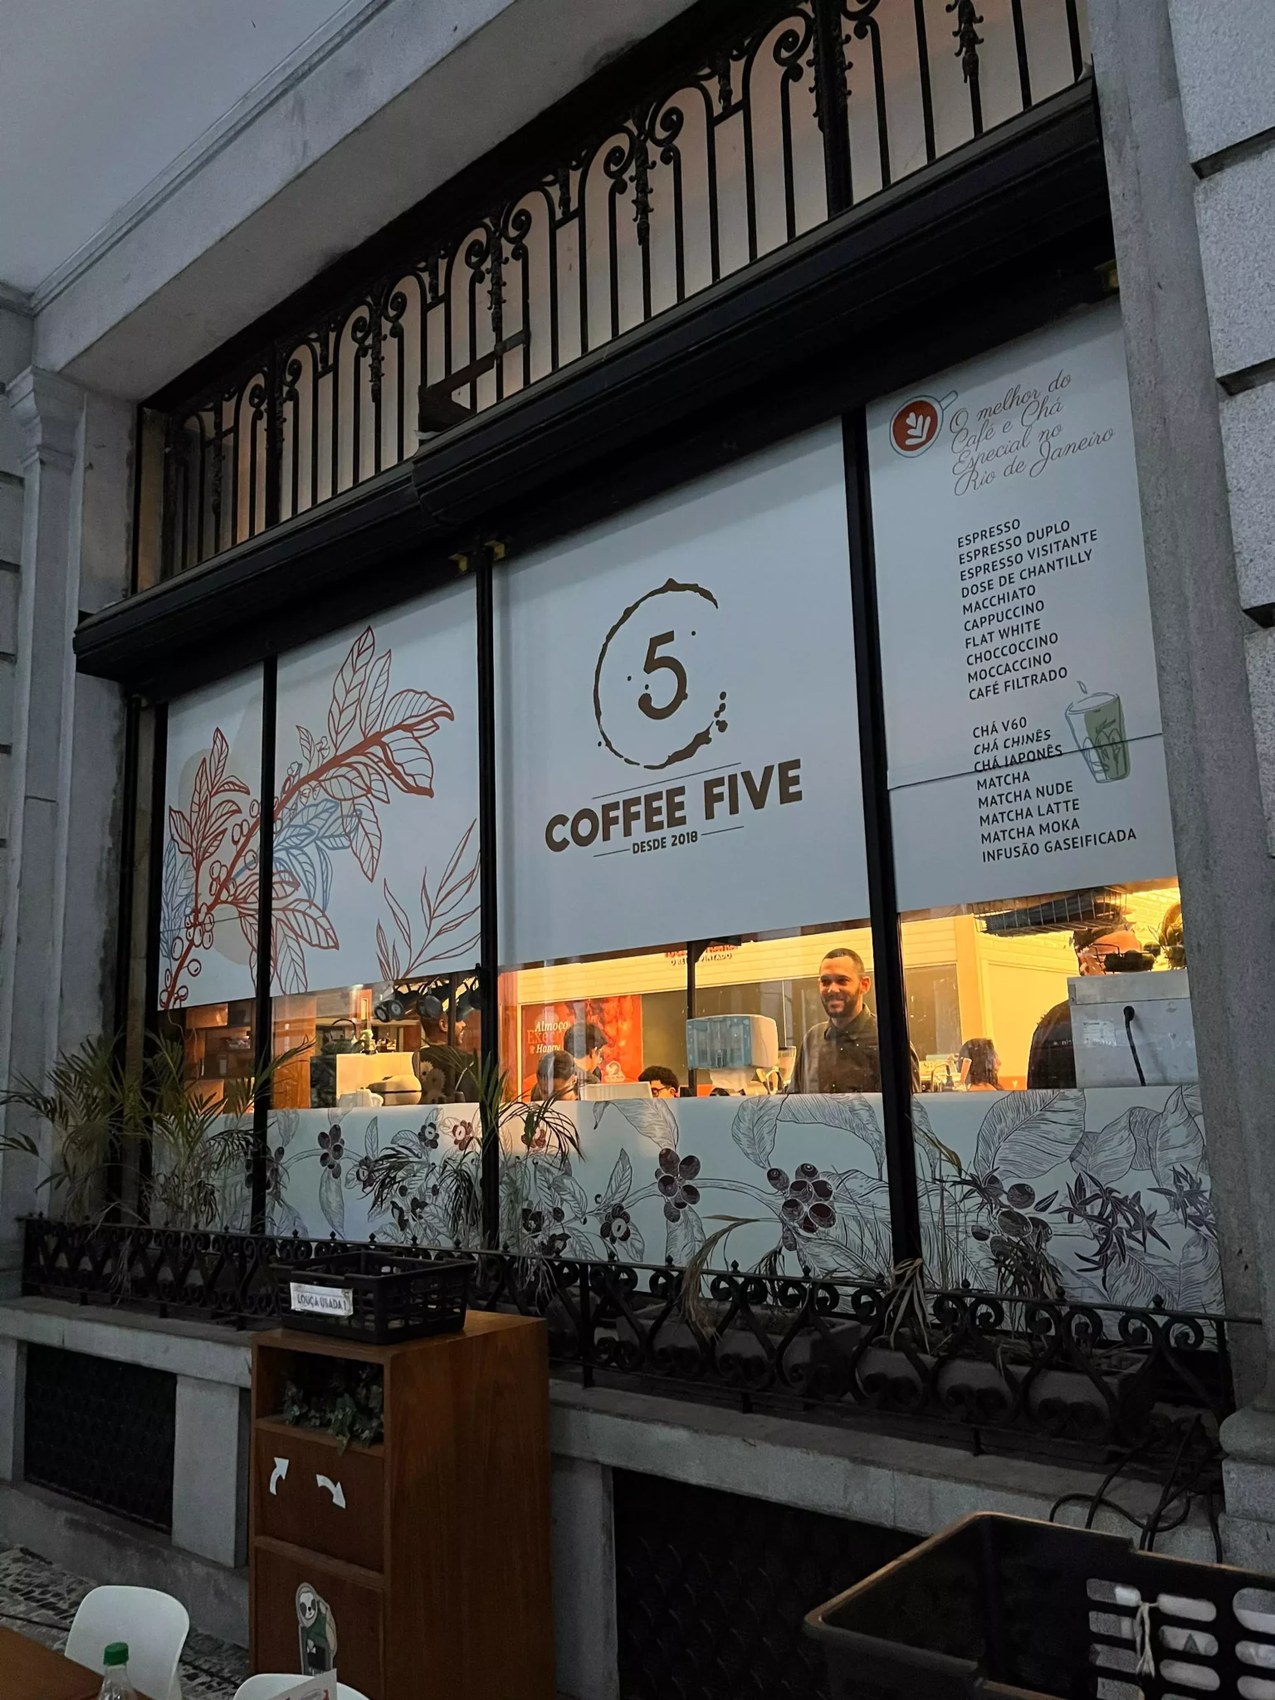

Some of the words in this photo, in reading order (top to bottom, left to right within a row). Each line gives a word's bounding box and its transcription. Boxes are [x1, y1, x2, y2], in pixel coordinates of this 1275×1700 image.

[950, 408, 968, 434] O
[976, 384, 1042, 422] melhor
[1048, 368, 1072, 392] do
[951, 419, 996, 454] Café
[1002, 420, 1013, 434] e
[1021, 396, 1064, 427] Chá
[952, 425, 1032, 476] Especial
[1038, 424, 1064, 442] no
[954, 470, 996, 496] Rio
[1003, 455, 1026, 478] de
[1029, 427, 1116, 478] Janeiro
[957, 518, 1020, 548] ESPRESSO
[959, 536, 1022, 564] ESPRESSO
[1027, 520, 1070, 543] DUPLO
[960, 552, 1023, 581] ESPRESSO
[1028, 529, 1098, 560] VISITANTE
[962, 579, 994, 598] DOSE
[998, 572, 1016, 587] DE
[1020, 549, 1092, 580] CHANTILLY
[962, 584, 1036, 615] MACCHIATO
[964, 600, 1044, 632] CAPPUCCINO
[965, 631, 995, 648] FLAT
[999, 618, 1041, 640] WHITE
[966, 632, 1058, 666] CHOCCOCCINO
[638, 630, 688, 720] 5
[968, 652, 1052, 684] MOCCACCINO
[969, 680, 1000, 700] CAFÉ
[1004, 666, 1068, 694] FILTRADO
[972, 718, 998, 738] CHÁ
[1002, 716, 1027, 731] V60
[974, 736, 999, 755] CHÁ
[1004, 729, 1051, 749] CHINÊS
[974, 755, 1000, 772] CHÁ
[976, 770, 1030, 790] MATCHA
[978, 789, 1032, 808] MATCHA
[1036, 780, 1074, 798] NUDE
[545, 785, 686, 852] COFFEE
[704, 758, 802, 820] FIVE
[980, 806, 1034, 826] MATCHA
[1038, 798, 1080, 817] LATTE
[632, 836, 667, 854] DESDE
[670, 830, 698, 847] 2018
[981, 825, 1034, 844] MATCHA
[1039, 818, 1080, 836] MOKA
[982, 842, 1040, 863] INFUSÃO
[1044, 828, 1136, 853] GASEIFICADA
[297, 1294, 320, 1308] LOUÇA
